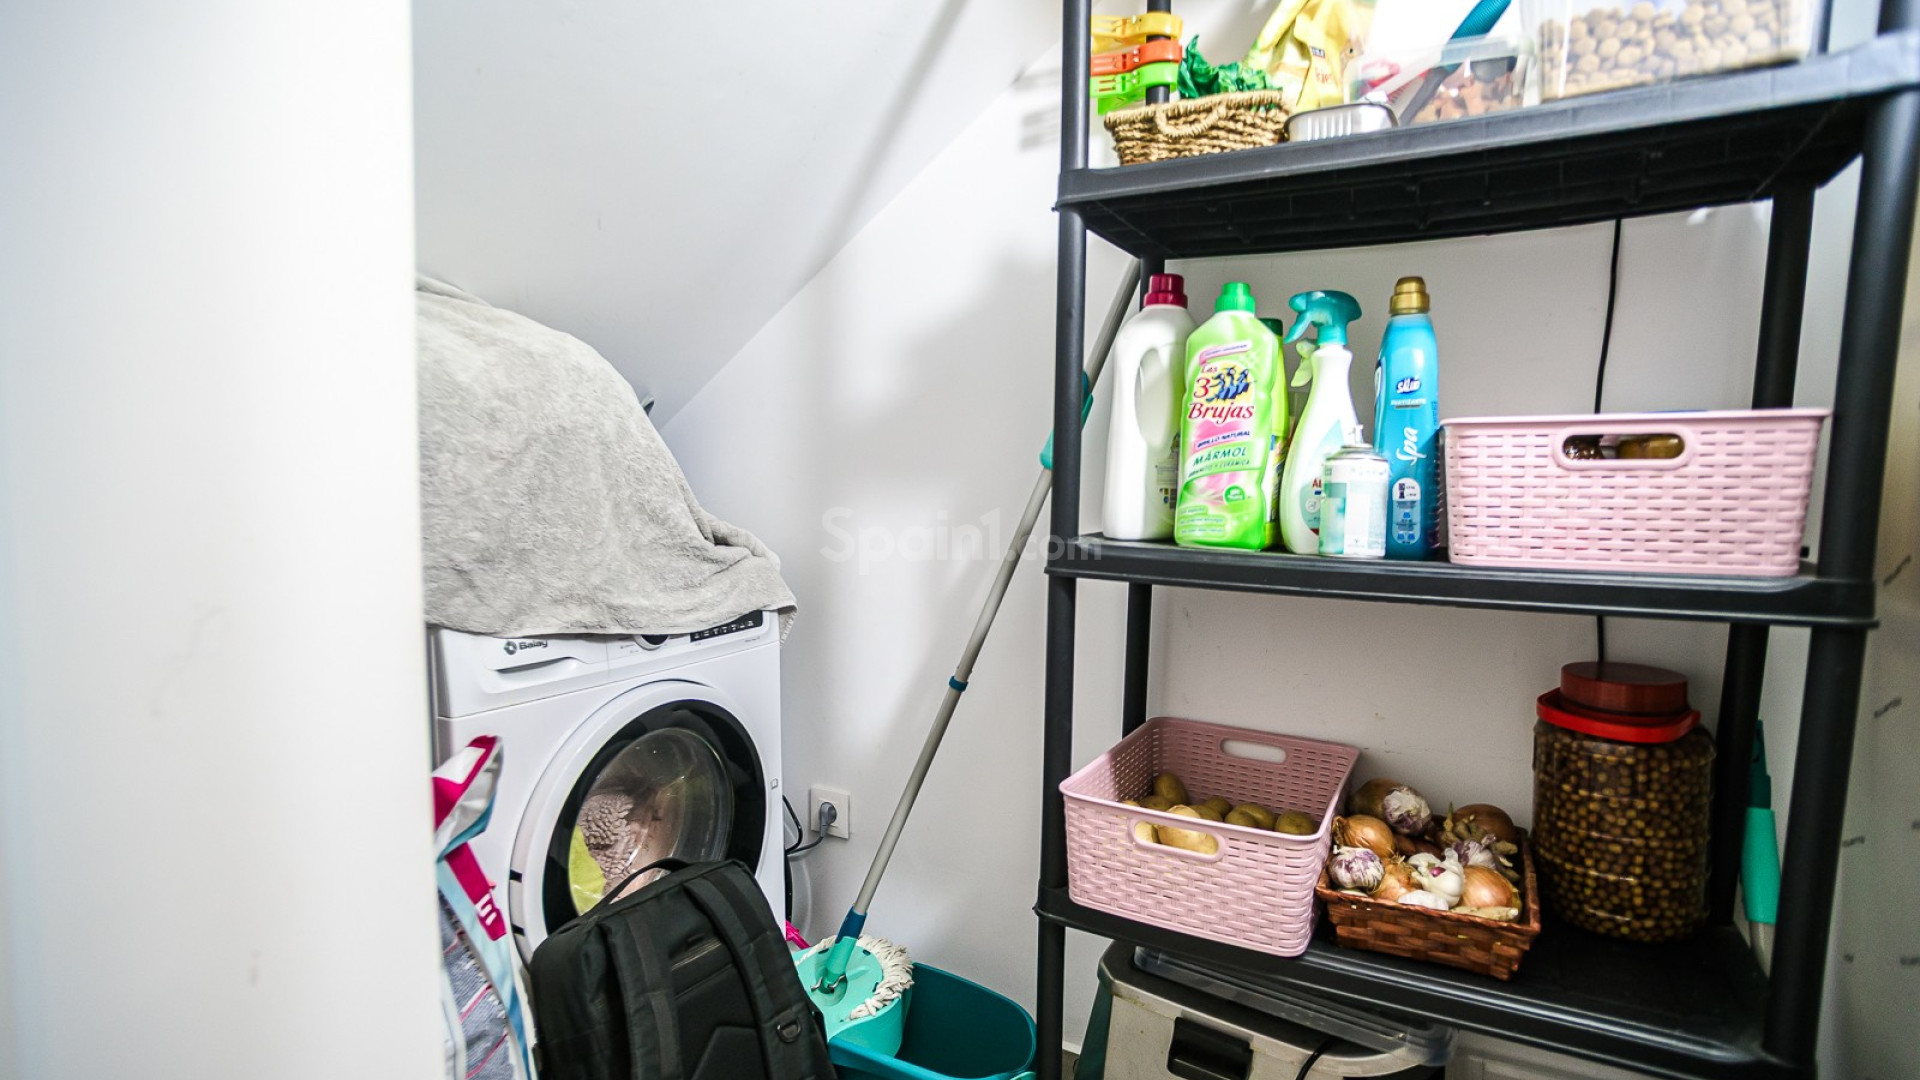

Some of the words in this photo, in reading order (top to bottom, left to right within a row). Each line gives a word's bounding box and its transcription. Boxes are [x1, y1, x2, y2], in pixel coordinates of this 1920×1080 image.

[1201, 365, 1218, 374] Las
[1193, 377, 1211, 399] 3
[1187, 401, 1255, 425] Brujas
[1192, 446, 1248, 467] MÁRMOL
[1395, 426, 1428, 467] Spa
[518, 639, 549, 651] Balay
